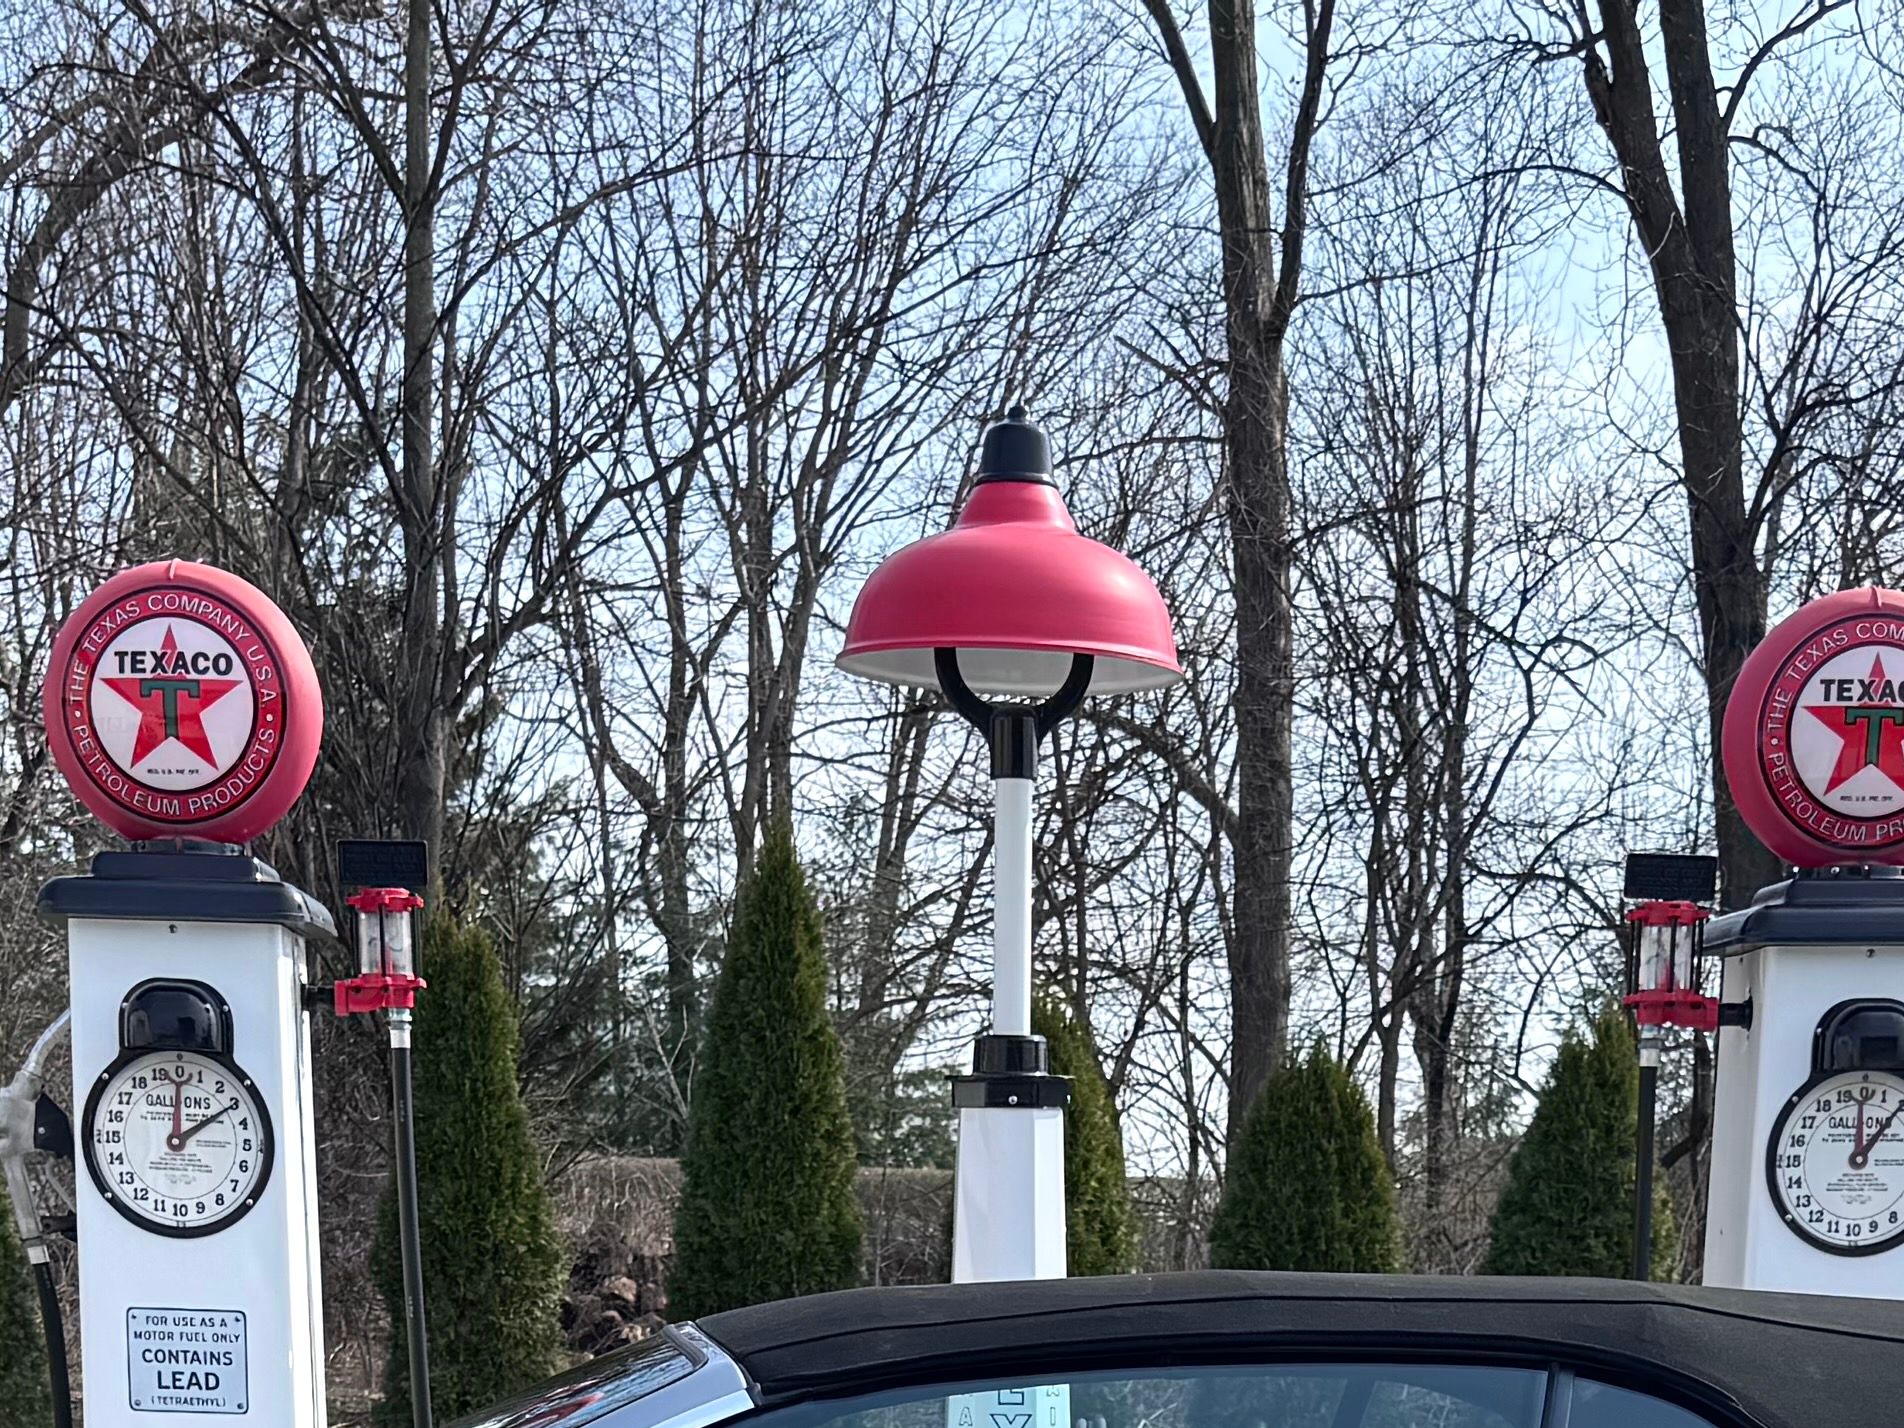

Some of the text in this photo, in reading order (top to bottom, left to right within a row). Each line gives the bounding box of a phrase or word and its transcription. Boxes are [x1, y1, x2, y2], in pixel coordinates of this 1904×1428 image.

[70, 659, 89, 705] THE
[82, 600, 140, 652] TEXAS
[147, 593, 250, 641] COMPANY
[114, 650, 234, 676] TEXACO
[1767, 687, 1792, 730] THE
[1786, 629, 1849, 681] TEXAS
[139, 679, 201, 740] T
[73, 724, 275, 816] PETROLEUM PRODUCTS
[1768, 752, 1866, 841] PETROLEUM
[151, 1068, 167, 1081] 19
[175, 1065, 185, 1079] 0
[197, 1070, 204, 1084] 1
[131, 1077, 147, 1089] 18
[215, 1081, 225, 1093] 2
[117, 1092, 133, 1105] 17
[1837, 1090, 1851, 1103] 19
[1859, 1086, 1869, 1099] 0
[1881, 1090, 1887, 1103] 1
[146, 1093, 211, 1110] GALLONS
[229, 1097, 240, 1111] 3
[1815, 1100, 1831, 1113] 18
[107, 1110, 124, 1123] 16
[1801, 1116, 1816, 1129] 17
[238, 1117, 248, 1130] 4
[105, 1130, 121, 1144] 15
[1790, 1134, 1805, 1147] 16
[242, 1139, 252, 1152] 5
[108, 1152, 124, 1165] 14
[1786, 1155, 1801, 1168] 15
[239, 1160, 249, 1173] 6
[119, 1171, 134, 1185] 13
[1787, 1176, 1802, 1189] 14
[230, 1179, 239, 1193] 7
[133, 1188, 149, 1201] 12
[215, 1193, 225, 1206] 8
[153, 1199, 166, 1212] 11
[196, 1201, 206, 1214] 9
[1796, 1195, 1811, 1208] 13
[172, 1204, 188, 1217] 10
[1808, 1210, 1824, 1223] 12
[1889, 1211, 1898, 1224] 8
[1826, 1220, 1839, 1233] 11
[1846, 1224, 1861, 1237] 10
[1869, 1221, 1878, 1233] 9
[145, 1315, 228, 1328] FOR USE AS A
[134, 1330, 240, 1343] MOTOR FUEL ONLY
[142, 1348, 233, 1366] CONTAINS
[157, 1370, 220, 1391] LEAD
